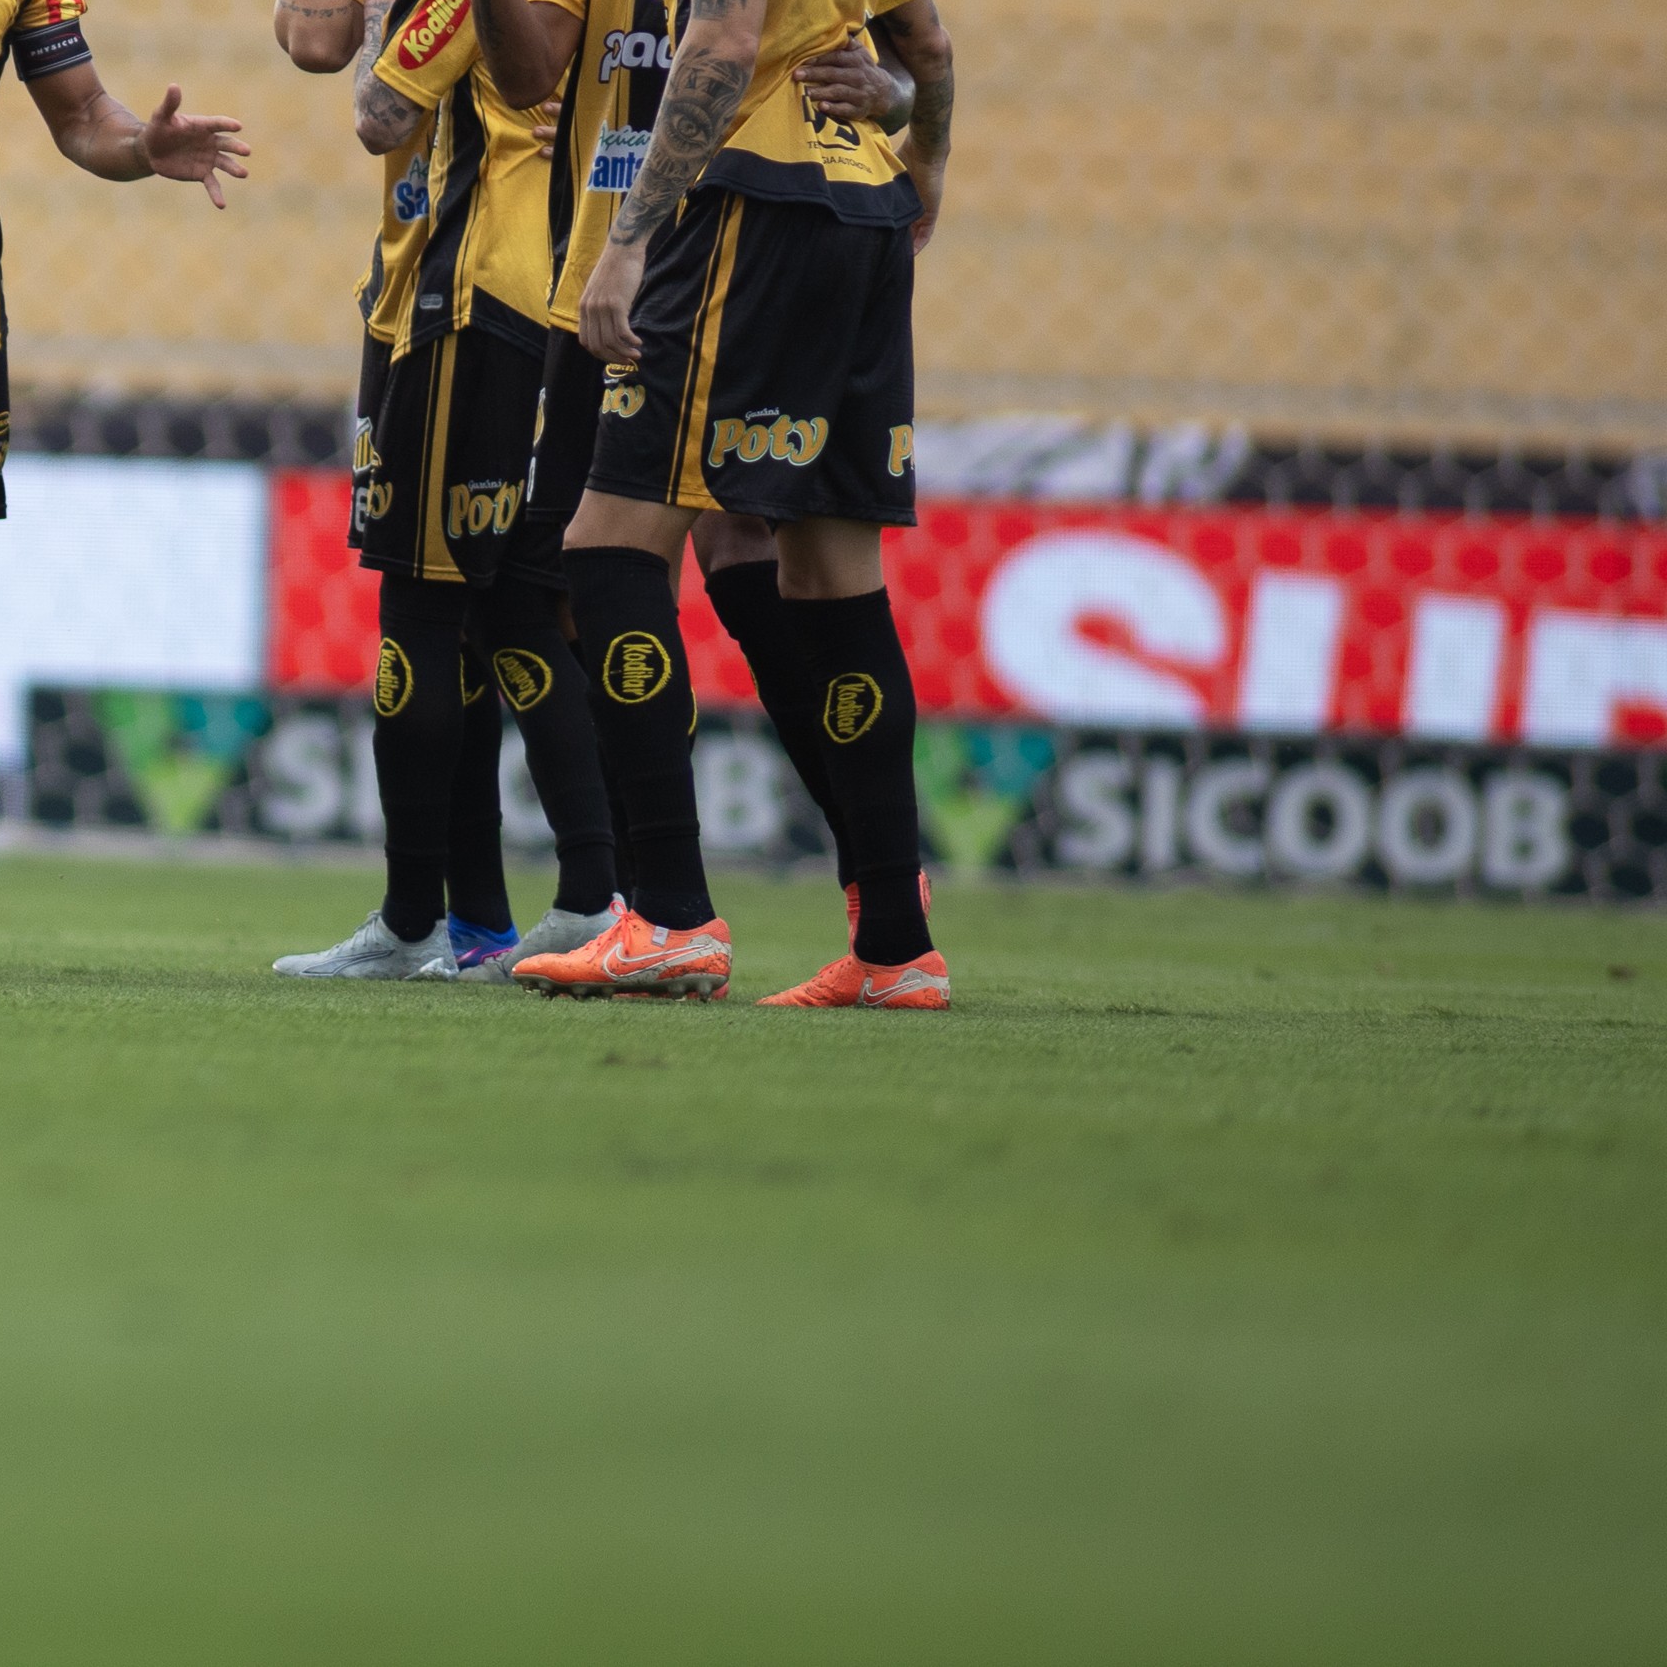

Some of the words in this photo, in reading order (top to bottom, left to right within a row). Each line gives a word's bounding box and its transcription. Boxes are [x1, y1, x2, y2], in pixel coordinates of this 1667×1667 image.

[30, 36, 79, 56] PHYSICUS
[708, 414, 829, 467] Poty
[447, 480, 525, 539] Poty
[622, 643, 655, 696] Kodilar
[836, 682, 867, 735] Kodilar
[1057, 749, 1568, 888] SICOOB
